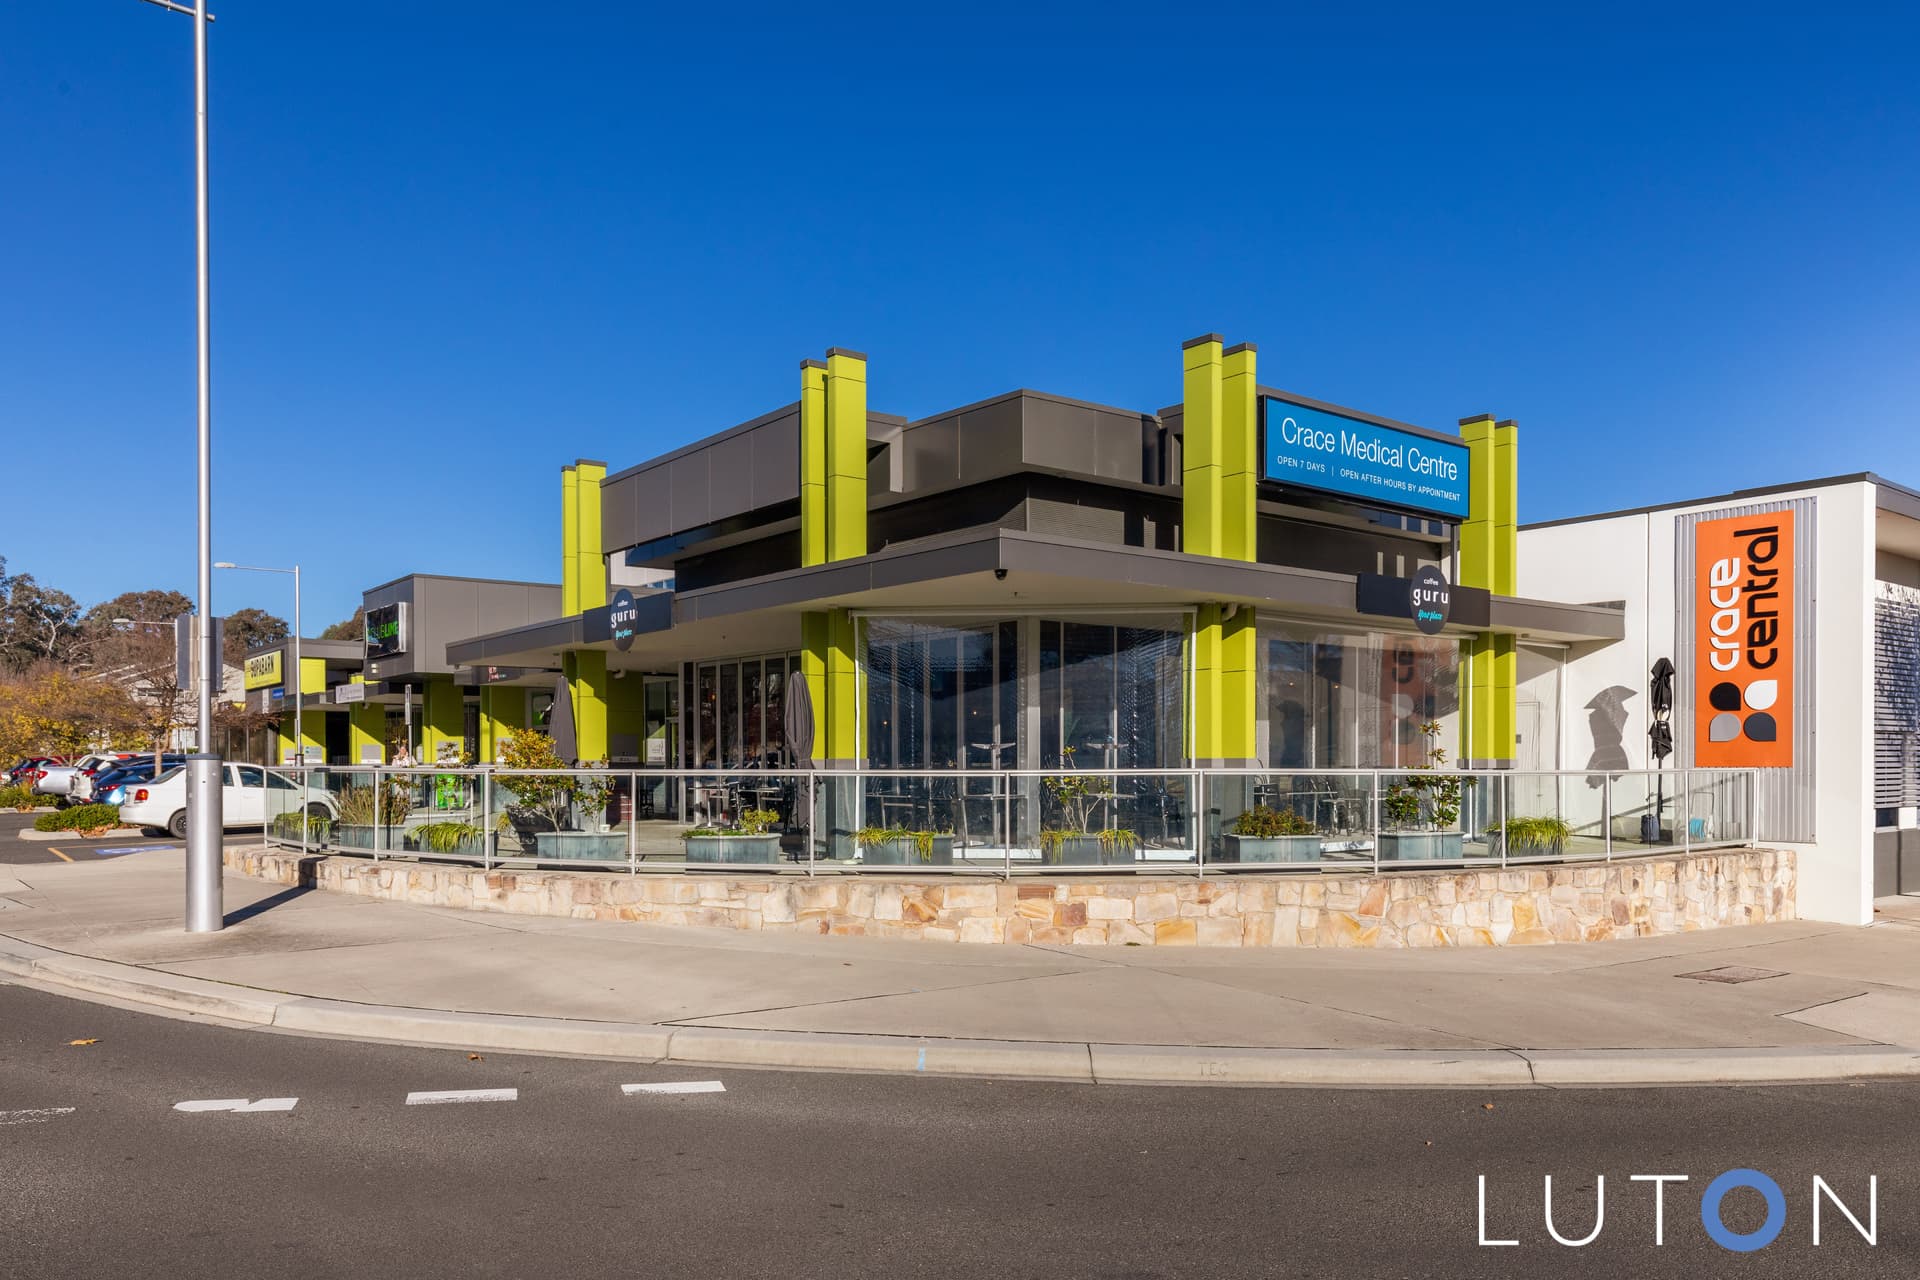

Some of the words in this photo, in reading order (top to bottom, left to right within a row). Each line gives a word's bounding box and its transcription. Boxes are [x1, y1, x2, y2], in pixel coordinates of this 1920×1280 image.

[1277, 455, 1298, 468] OPEN
[1300, 460, 1305, 469] 7
[1306, 460, 1326, 473] DAYS
[1282, 417, 1335, 453] Crace
[1341, 430, 1403, 469] Medical
[1408, 447, 1457, 481] Centre
[1339, 468, 1359, 480] OPEN
[1361, 472, 1382, 486] AFTER
[1383, 477, 1407, 491] HOURS
[1407, 483, 1417, 493] BY
[1418, 485, 1461, 502] APPOINTMENT
[1413, 588, 1449, 606] guru
[1709, 557, 1741, 671] crace
[1733, 525, 1779, 670] central
[611, 609, 636, 629] guru
